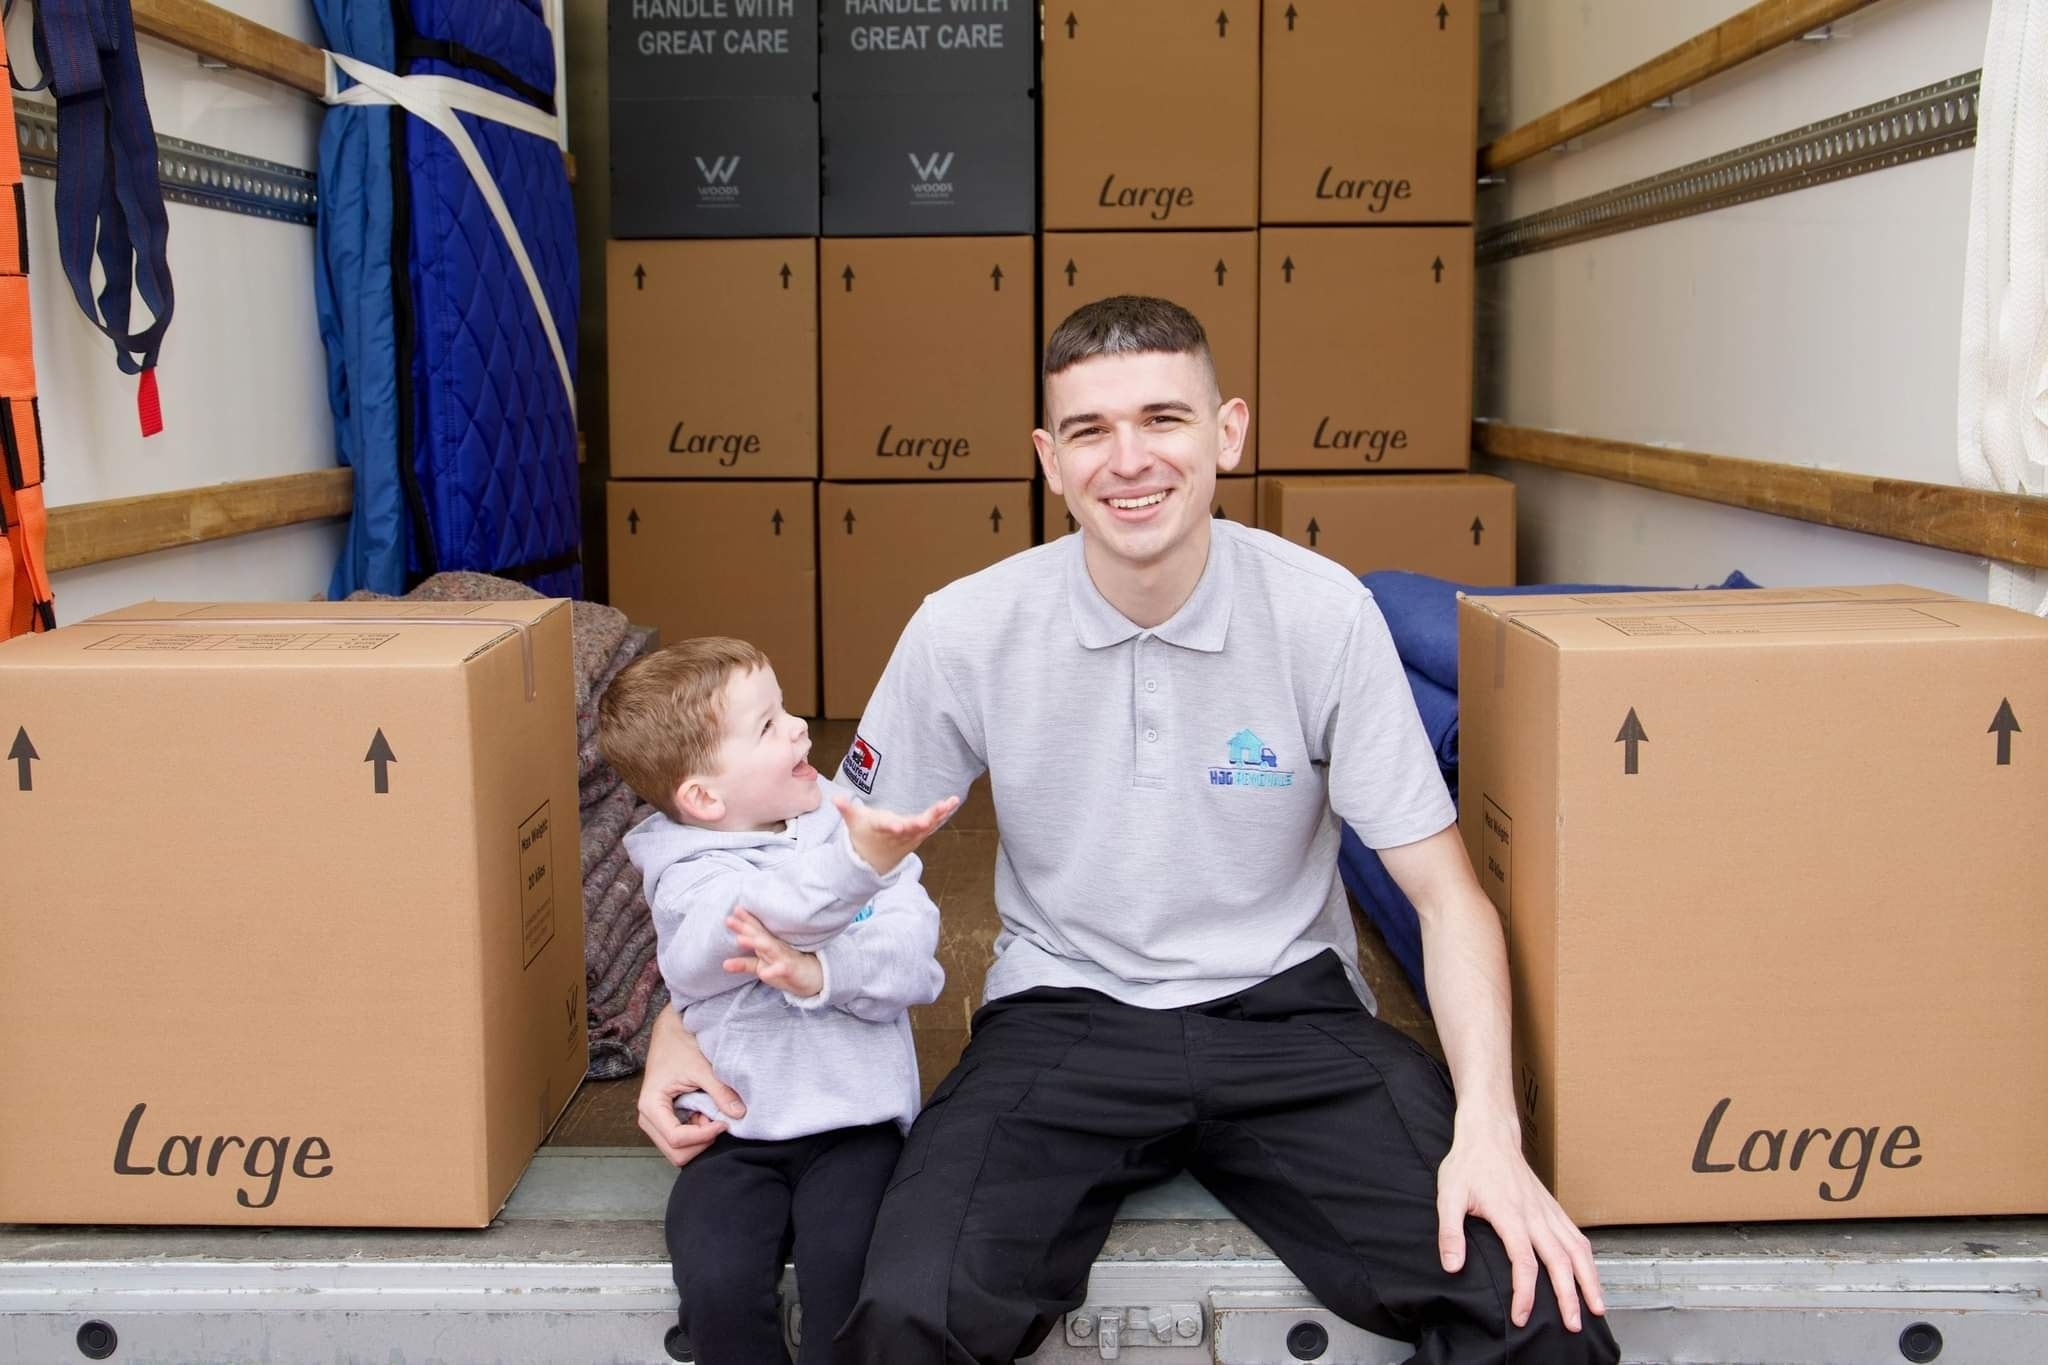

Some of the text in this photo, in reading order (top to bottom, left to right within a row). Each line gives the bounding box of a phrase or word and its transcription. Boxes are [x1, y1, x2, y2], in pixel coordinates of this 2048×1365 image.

[633, 0, 793, 18] HANDLE WITH
[845, 0, 1008, 14] HANDLE WITH
[638, 28, 789, 55] GREAT CARE
[850, 23, 1004, 51] GREAT CARE
[1099, 173, 1194, 221] Large
[1315, 166, 1412, 213] Large
[668, 421, 761, 467] Large
[876, 424, 970, 471] Large
[1312, 416, 1408, 463] Large
[113, 1102, 334, 1209] Large
[1691, 1097, 1923, 1203] Large
